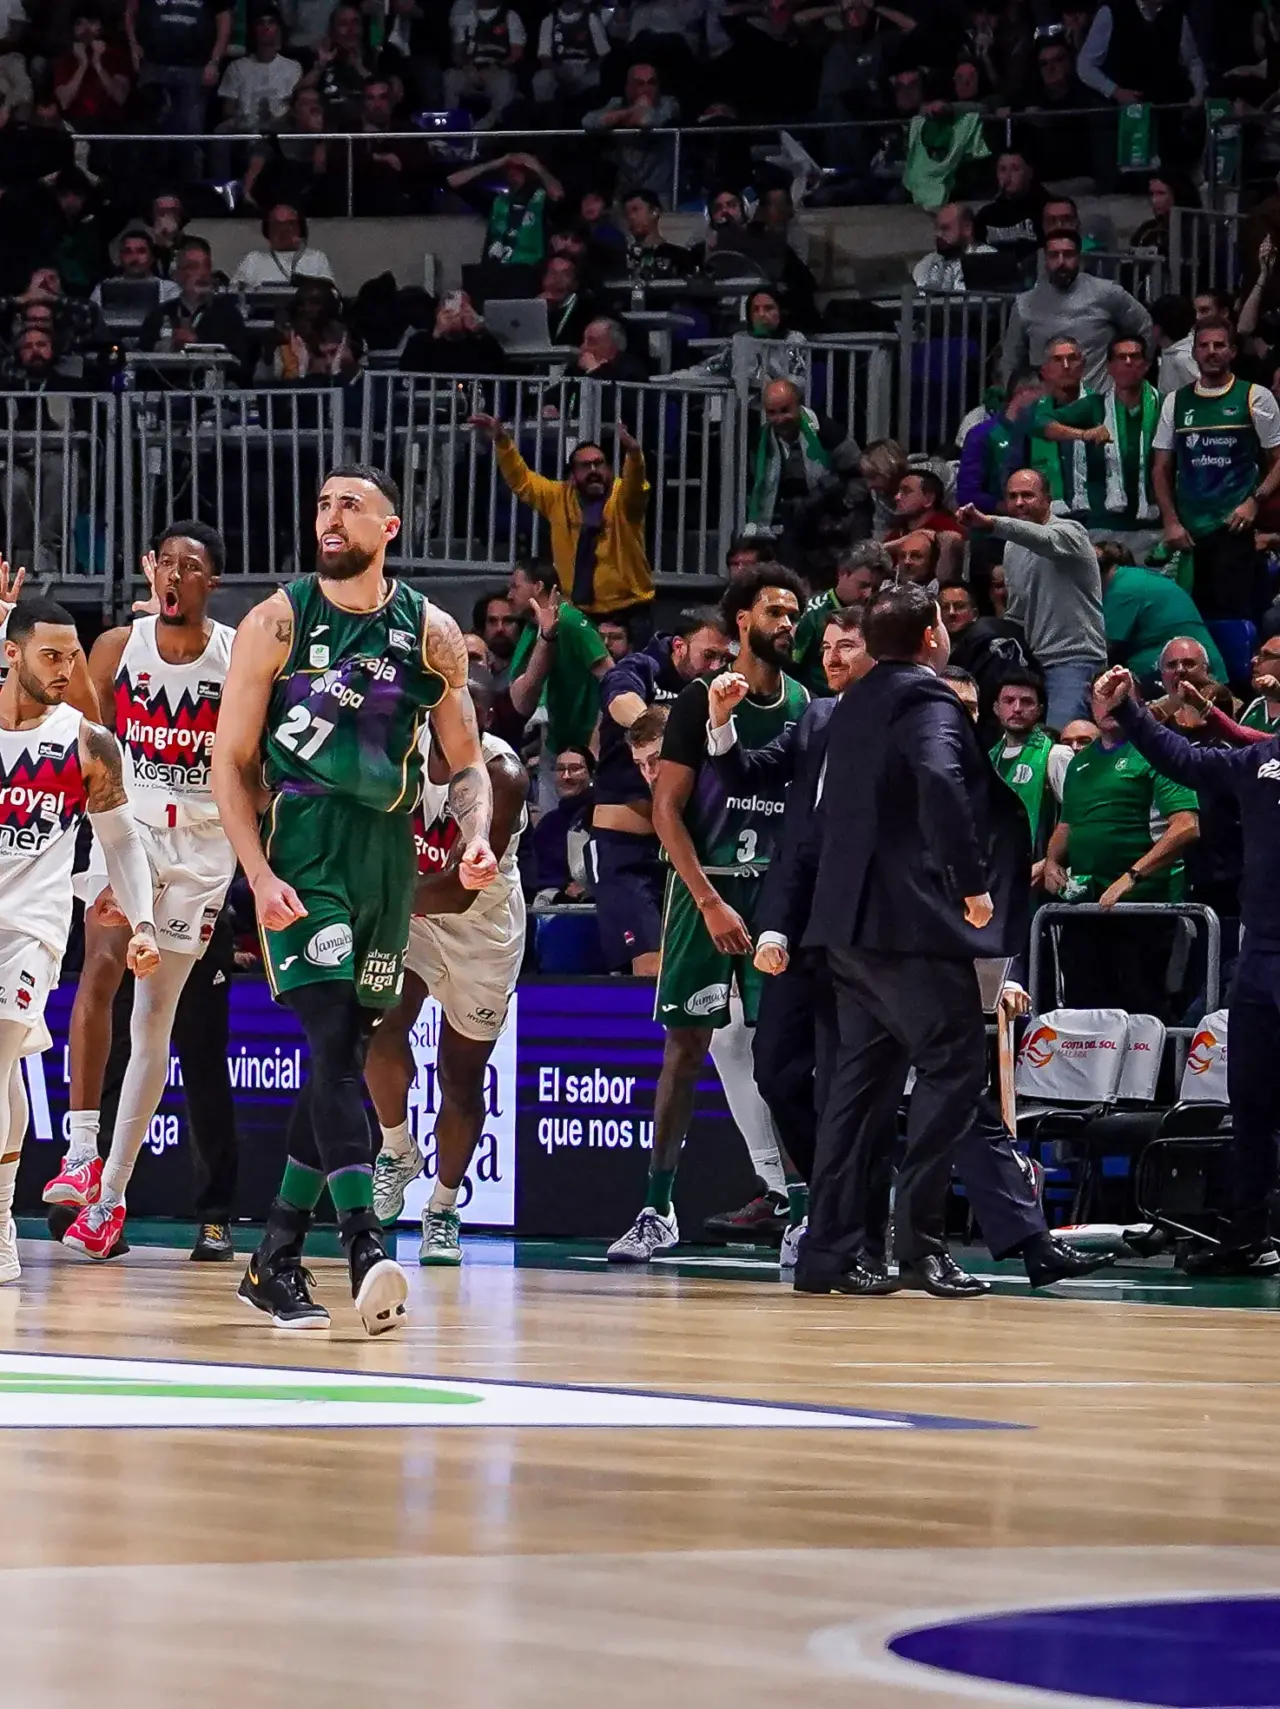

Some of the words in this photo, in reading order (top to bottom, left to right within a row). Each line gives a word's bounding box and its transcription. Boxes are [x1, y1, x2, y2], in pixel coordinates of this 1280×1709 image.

[274, 704, 335, 761] 27
[165, 804, 177, 828] 1
[736, 829, 758, 863] 3
[1099, 1040, 1118, 1050] SOL
[1133, 1042, 1151, 1051] SOL
[227, 1046, 301, 1089] vincial
[538, 1066, 559, 1102] El
[566, 1068, 635, 1105] sabor
[537, 1117, 590, 1155] que
[588, 1120, 633, 1149] nos
